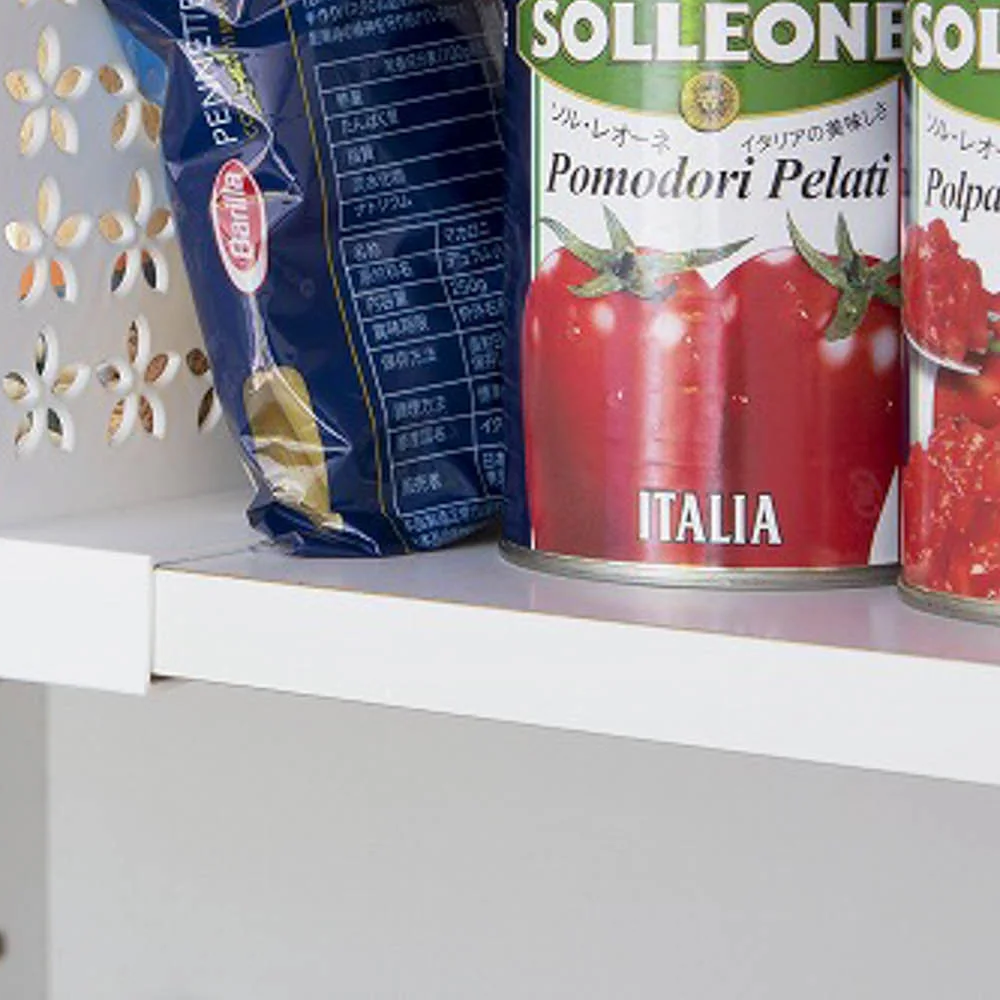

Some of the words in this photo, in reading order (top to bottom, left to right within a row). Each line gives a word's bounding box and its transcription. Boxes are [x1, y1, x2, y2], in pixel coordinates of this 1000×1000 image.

[741, 100, 889, 154] イタリアの美味しさ
[545, 151, 755, 199] Pomodori
[768, 153, 891, 199] Pelati
[638, 489, 783, 546] ITALIA
